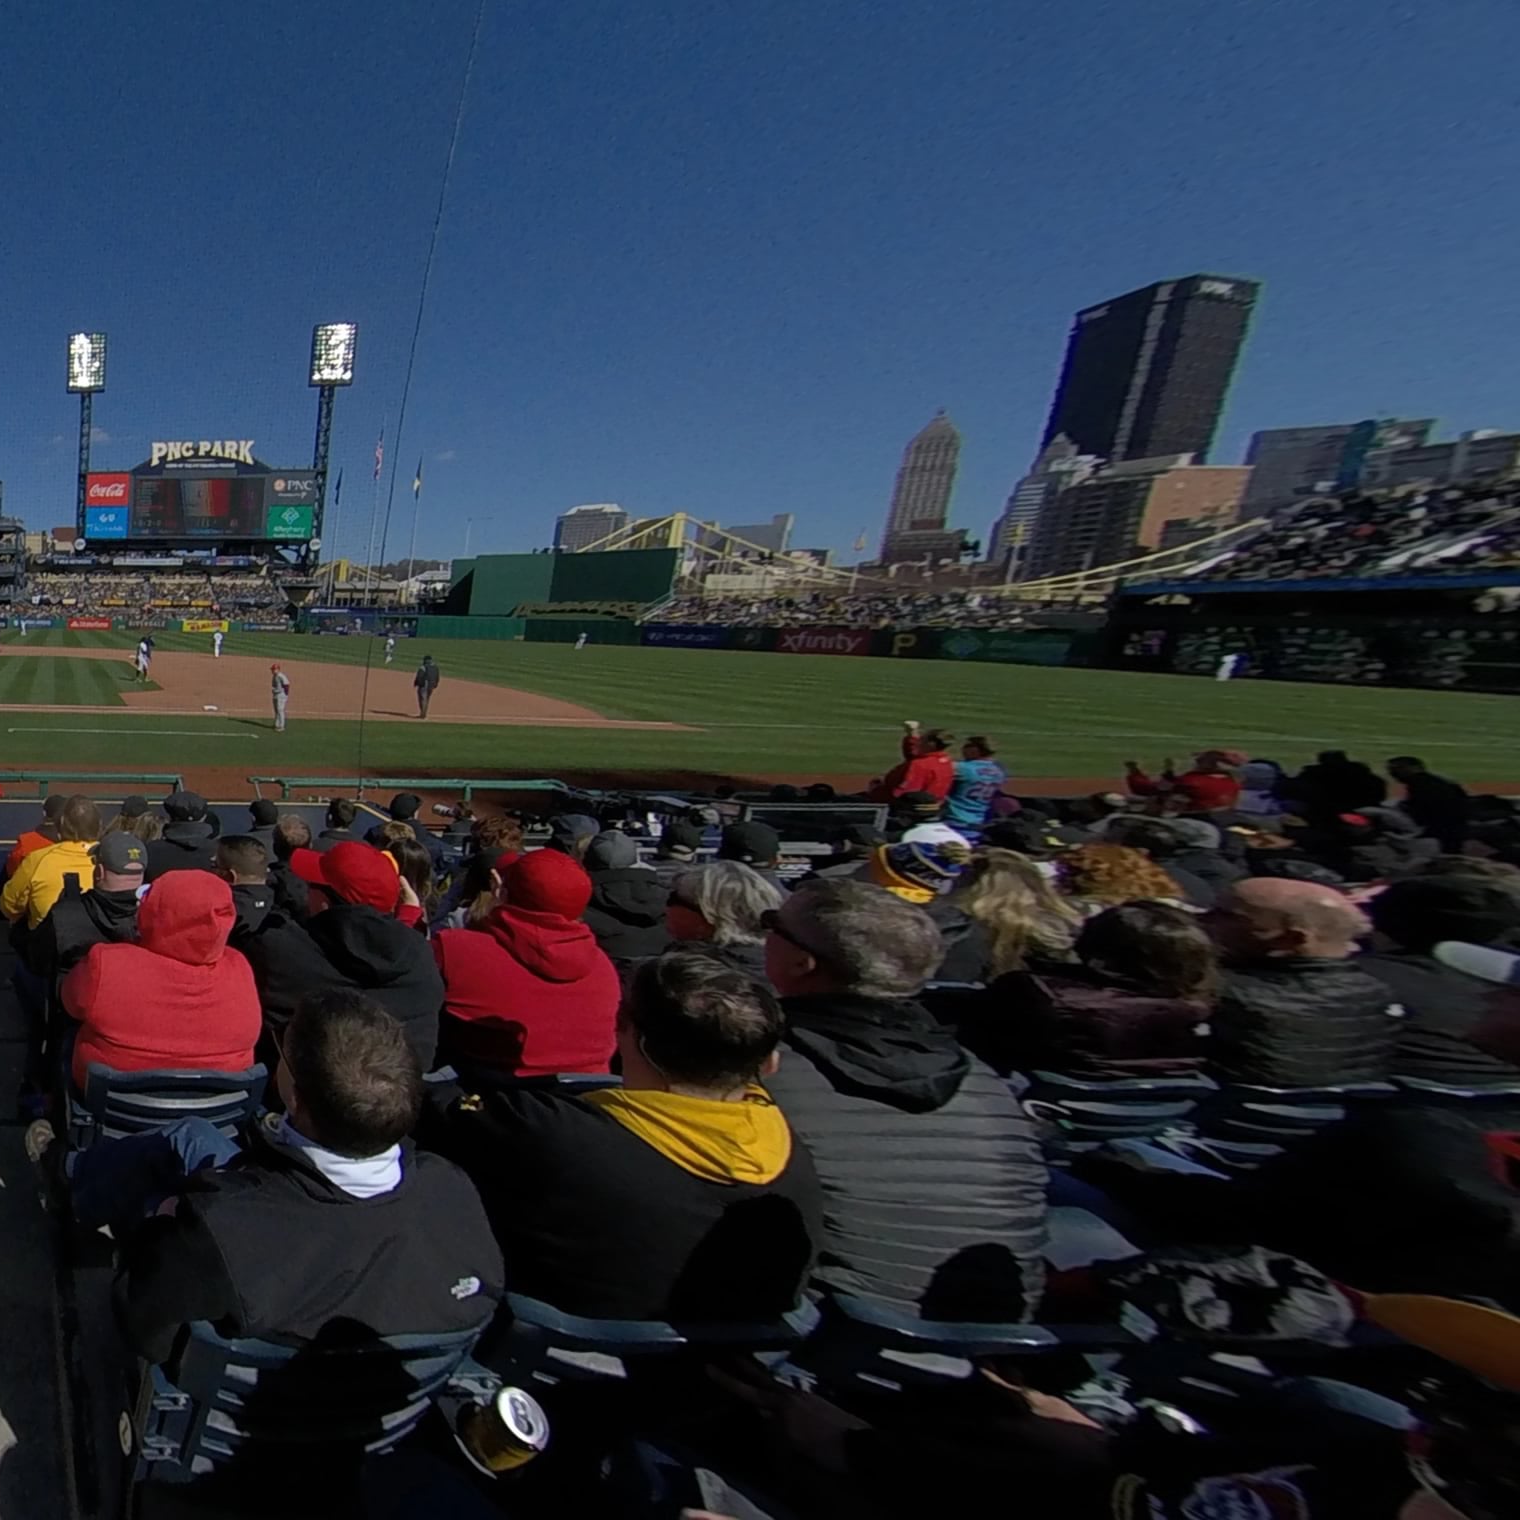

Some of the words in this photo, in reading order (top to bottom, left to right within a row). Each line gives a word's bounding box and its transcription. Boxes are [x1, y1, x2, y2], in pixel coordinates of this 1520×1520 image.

[150, 442, 194, 467] PNC
[198, 440, 254, 465] PARK
[288, 480, 313, 491] PNC
[782, 631, 863, 652] xfinity
